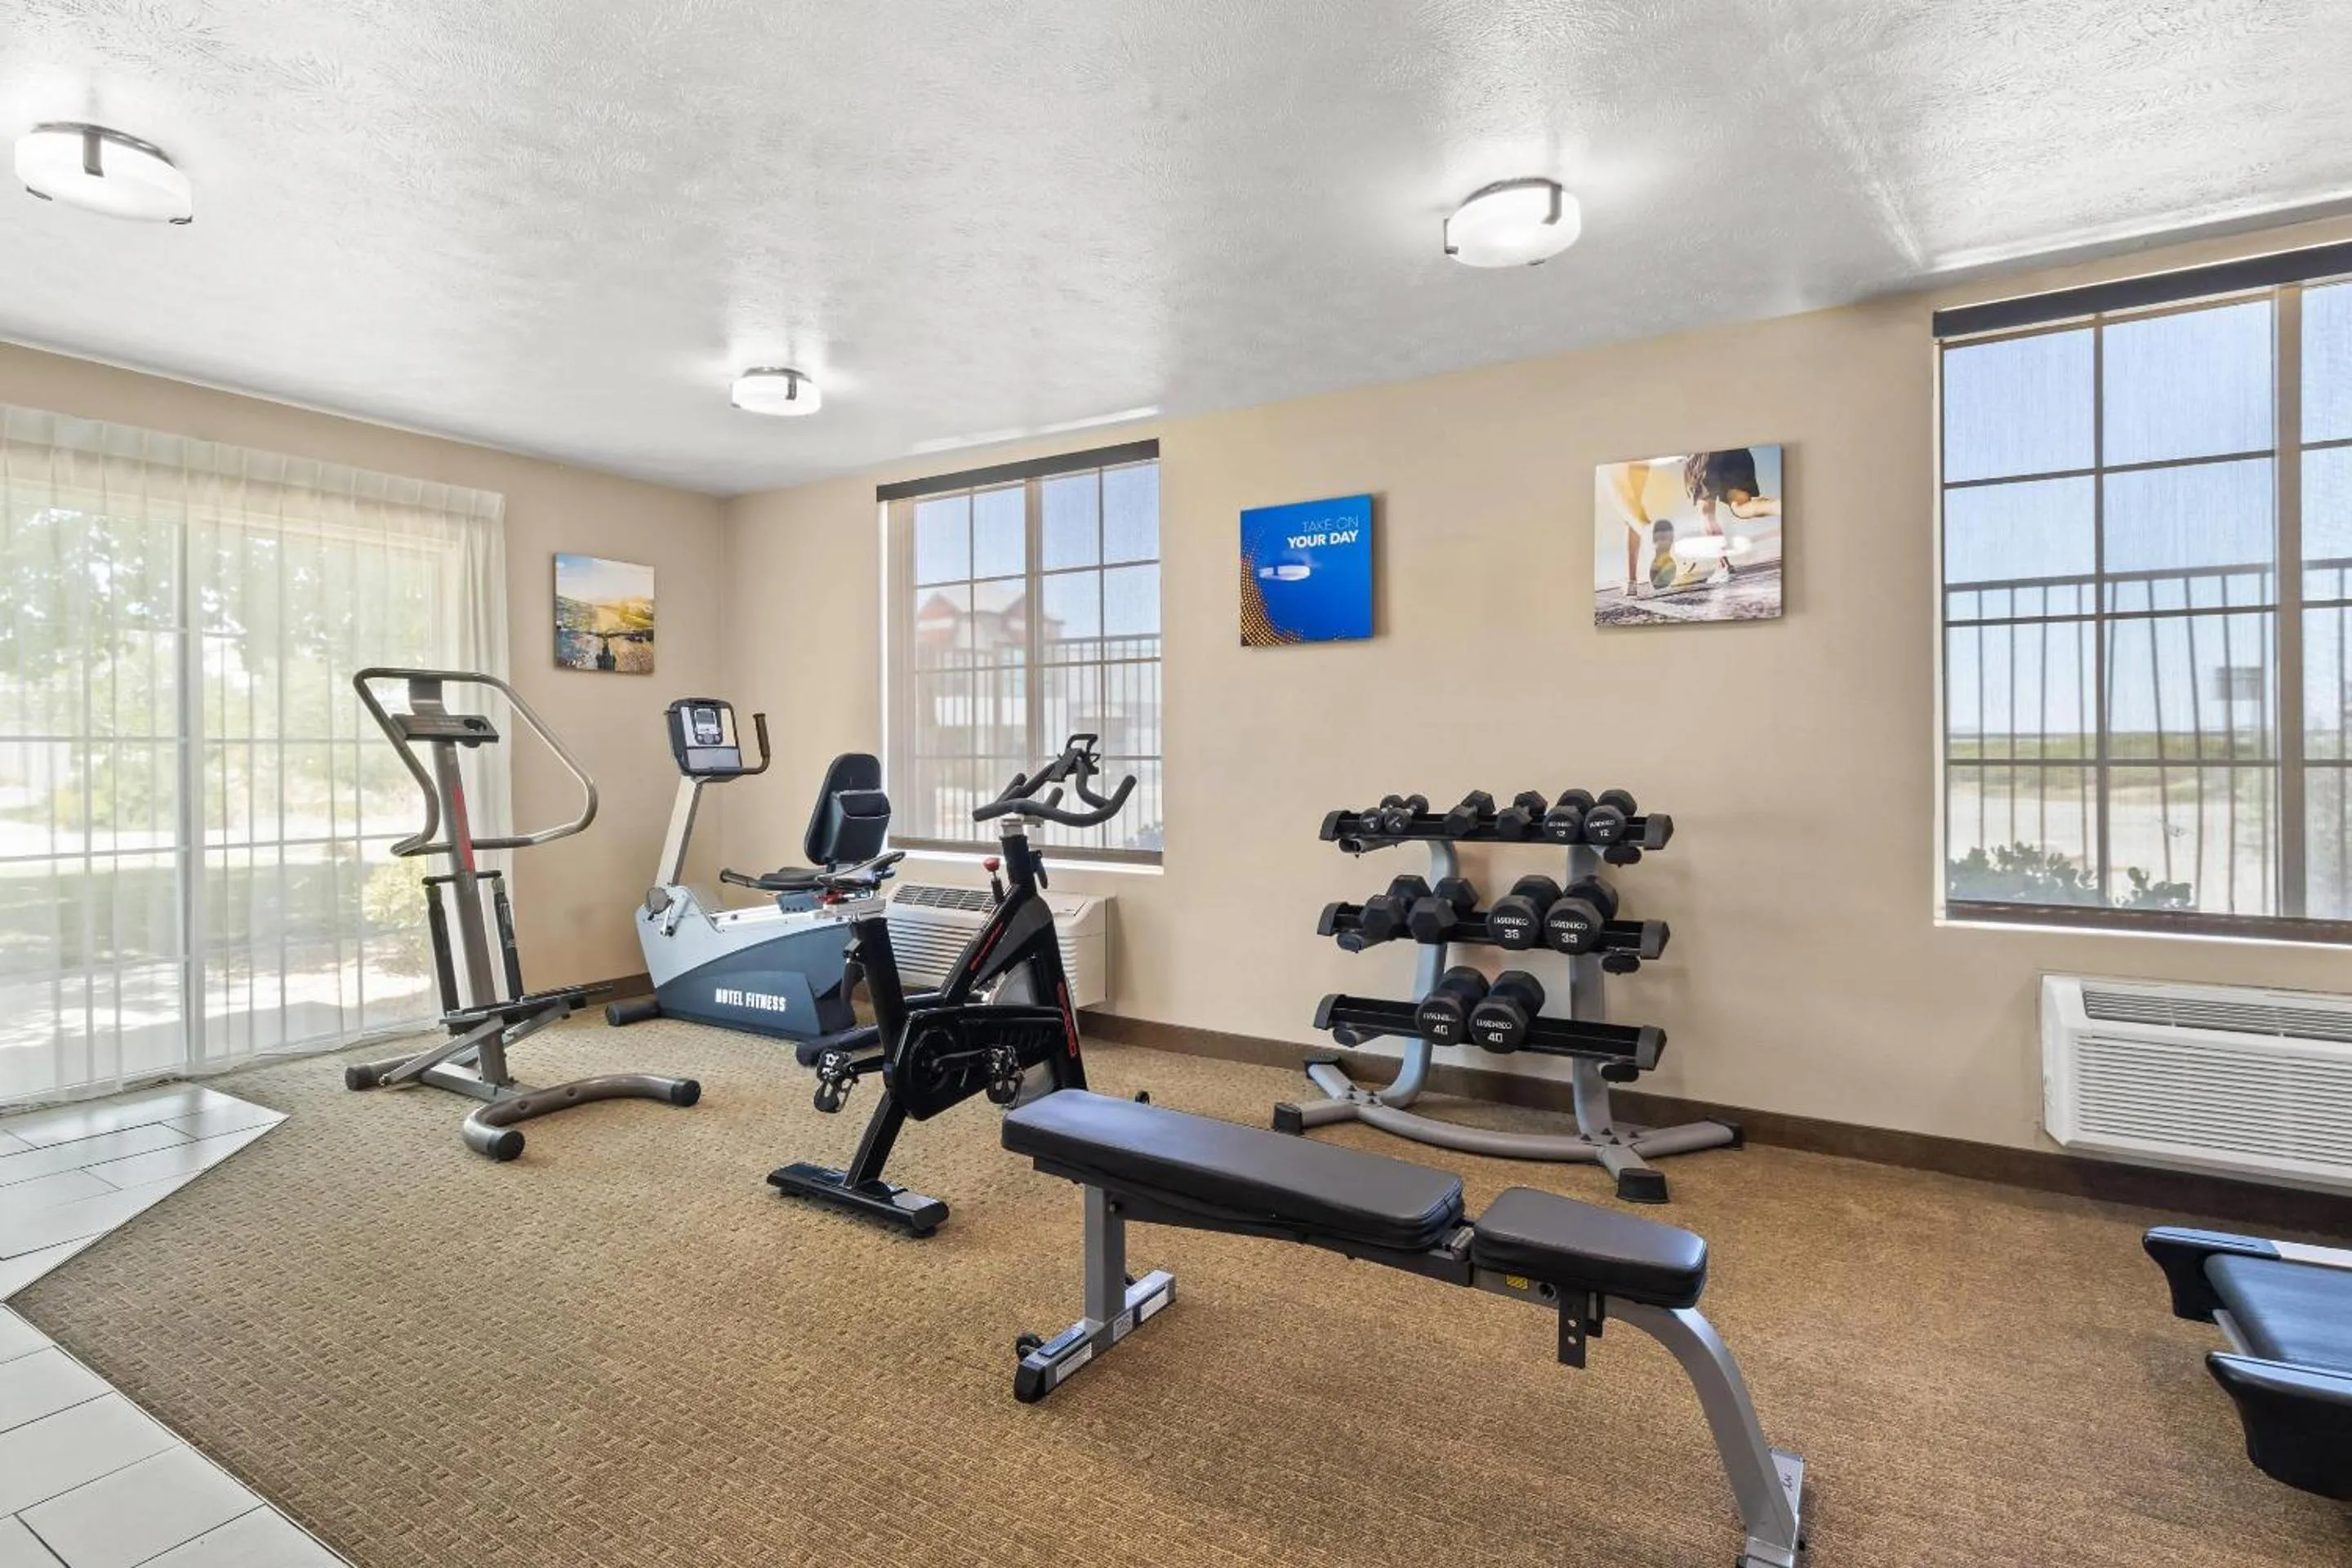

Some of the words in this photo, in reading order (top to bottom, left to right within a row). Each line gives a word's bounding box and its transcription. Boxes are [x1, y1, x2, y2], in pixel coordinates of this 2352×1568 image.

[1303, 518, 1333, 532] TAKE
[1336, 514, 1359, 530] ON
[1287, 533, 1326, 549] YOUR
[1330, 529, 1359, 545] DAY
[1504, 929, 1520, 939] 35
[1561, 933, 1578, 943] 35
[715, 988, 743, 1005] HOTEL
[746, 991, 786, 1012] FITNESS
[1433, 1025, 1448, 1036] 40
[1488, 1032, 1503, 1043] 40
